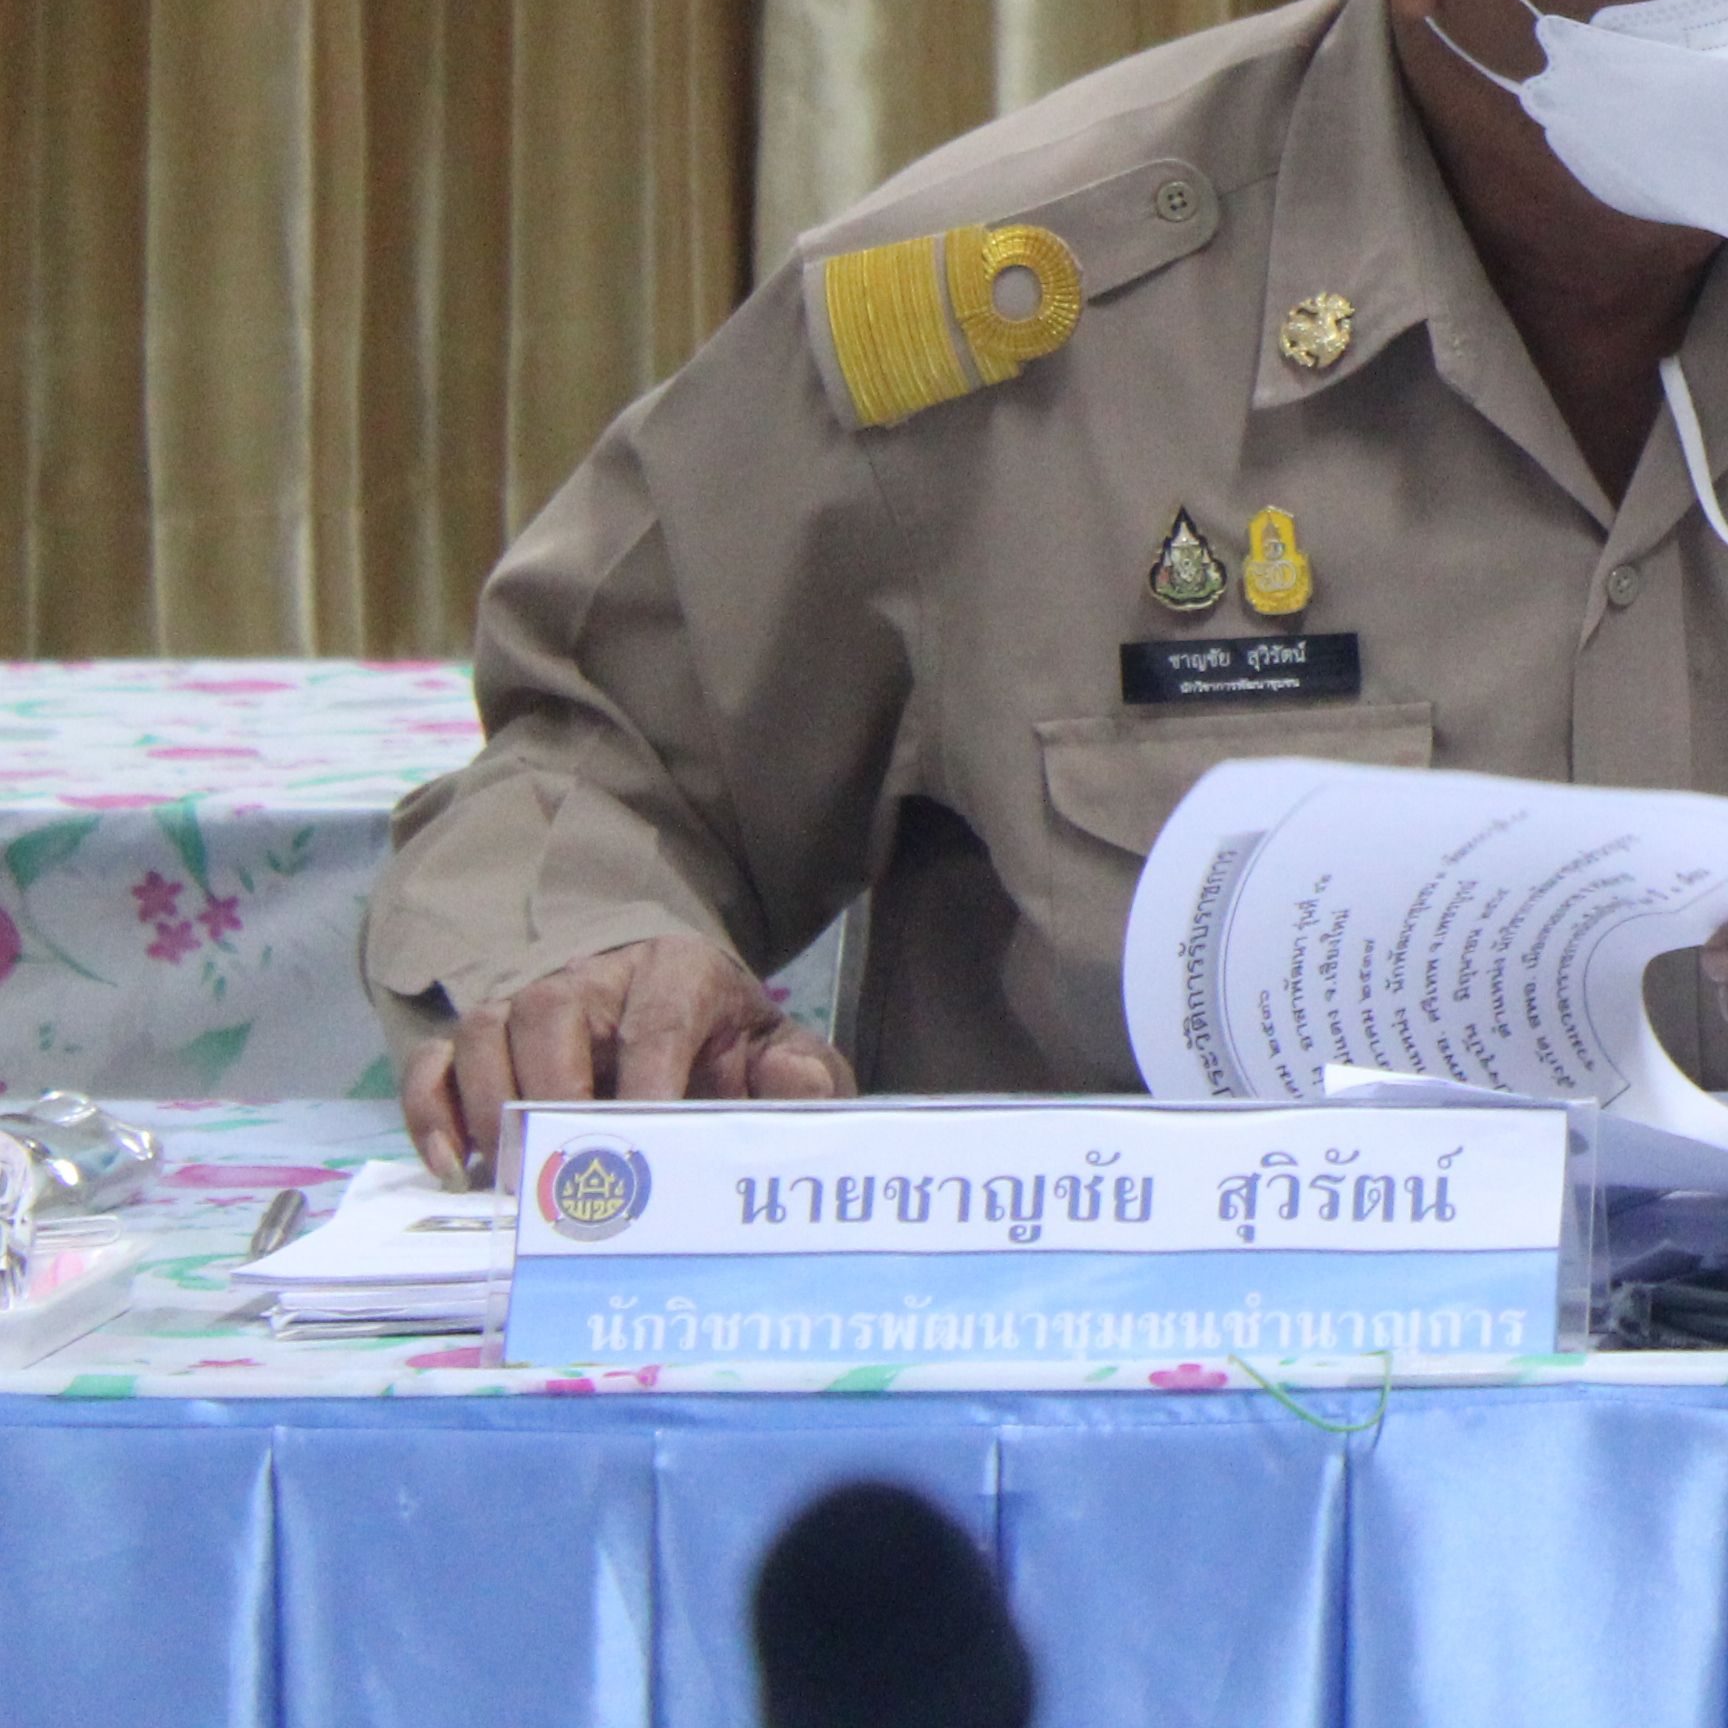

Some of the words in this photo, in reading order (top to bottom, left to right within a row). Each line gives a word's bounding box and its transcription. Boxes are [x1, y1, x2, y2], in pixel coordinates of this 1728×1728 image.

[1168, 646, 1231, 671] ชาญชัย
[735, 1149, 1154, 1242] นายชาญชัย
[1217, 1145, 1464, 1242] สุวิรัตน์
[586, 1292, 1526, 1354] นักวิชาการพัฒนาชุมชนชำนาญการ
